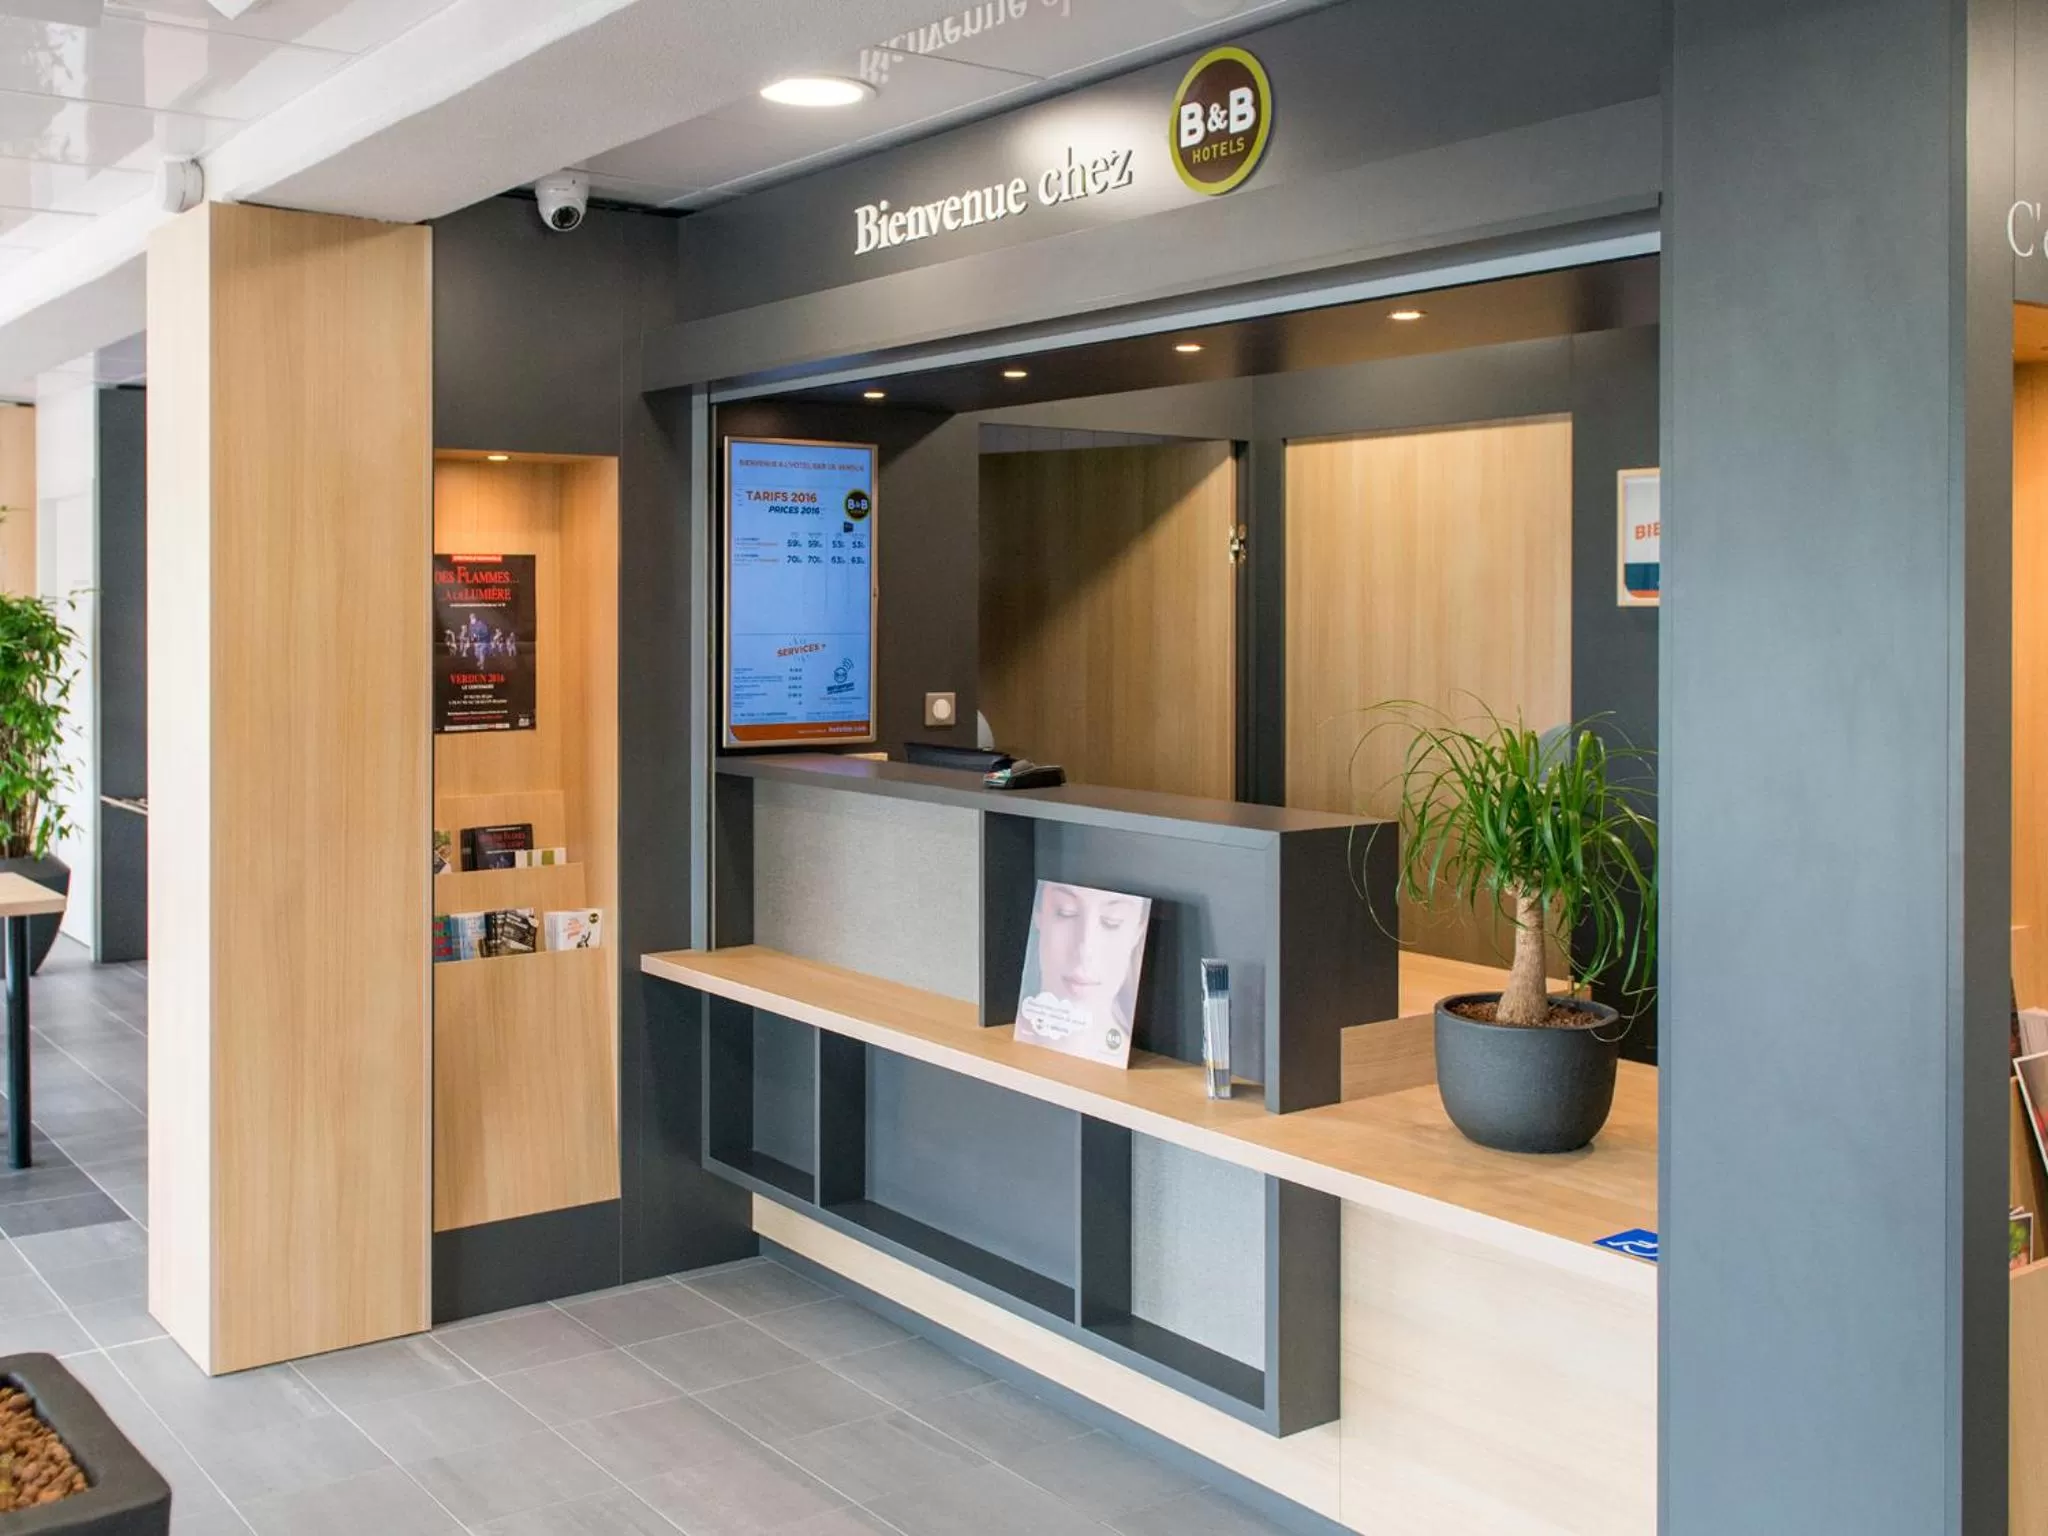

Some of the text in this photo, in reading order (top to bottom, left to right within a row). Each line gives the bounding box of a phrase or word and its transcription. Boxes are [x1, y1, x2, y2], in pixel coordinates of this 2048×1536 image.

[1180, 86, 1256, 148] B&B
[1192, 137, 1244, 163] HOTELS
[854, 146, 1135, 255] Bienvenue chez
[745, 490, 817, 503] TARIFS 2016
[768, 506, 820, 515] PRICES 2016
[847, 498, 868, 510] B&B
[776, 643, 820, 657] SERVICES
